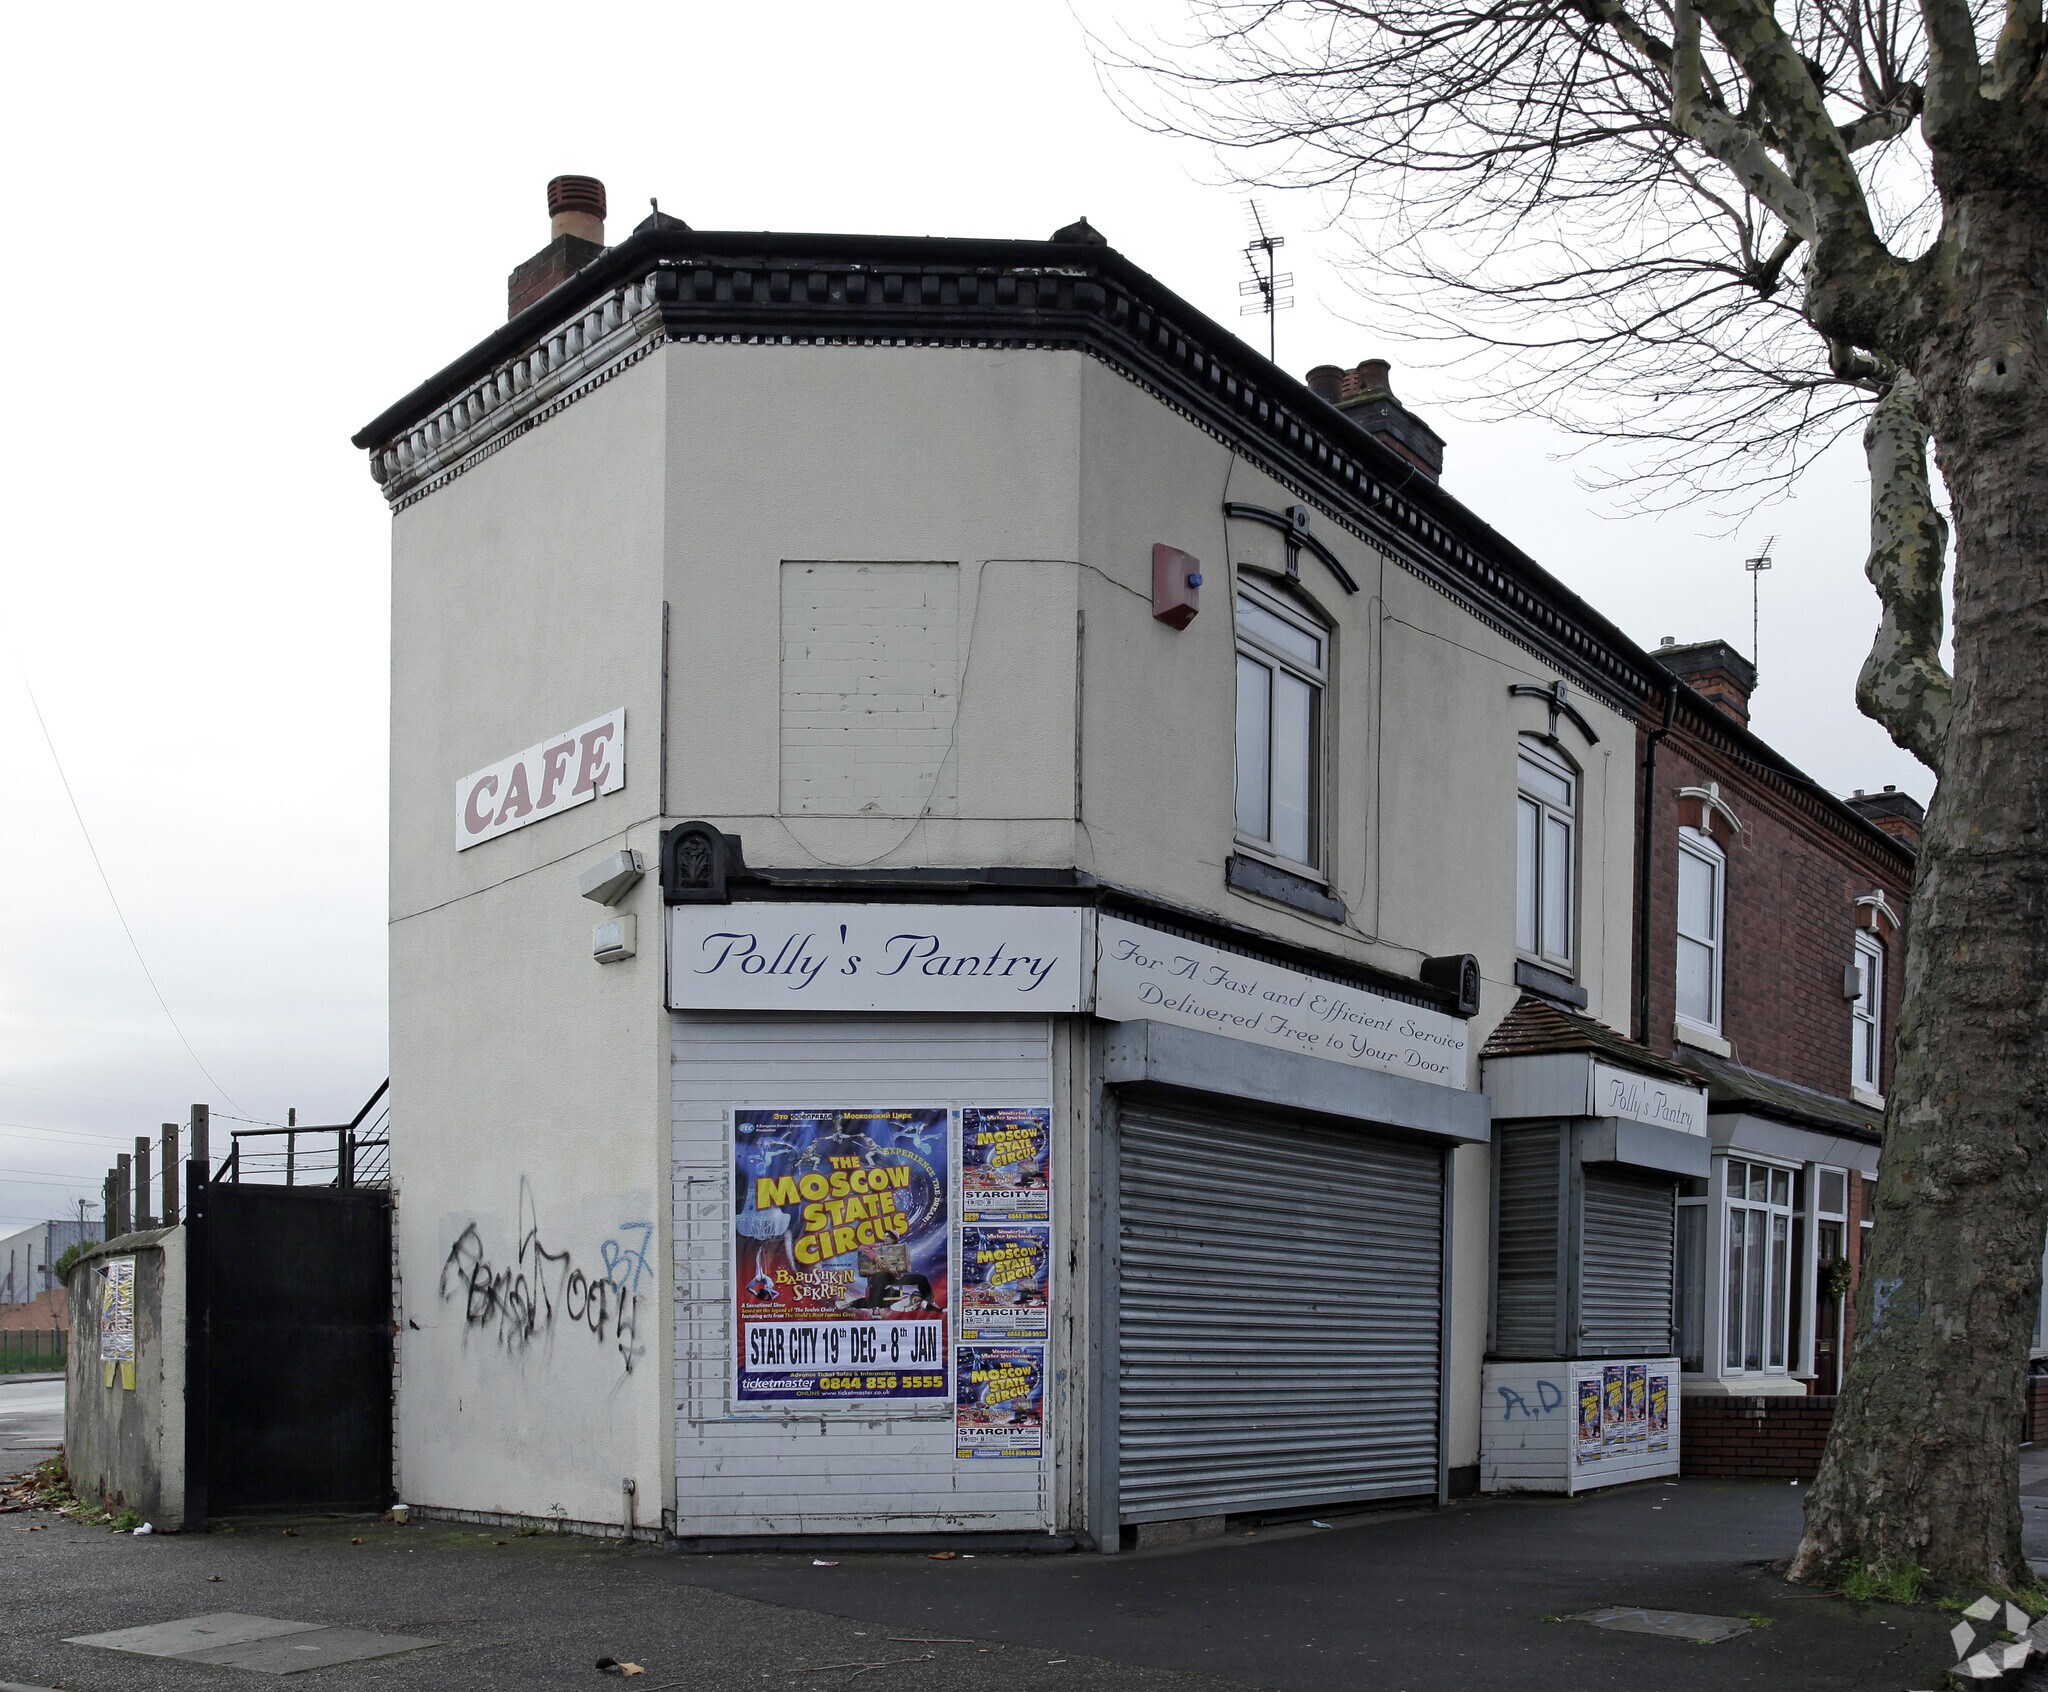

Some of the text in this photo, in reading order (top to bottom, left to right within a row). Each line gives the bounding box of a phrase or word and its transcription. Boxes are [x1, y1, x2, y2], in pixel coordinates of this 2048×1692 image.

[464, 721, 615, 835] CAFE
[693, 923, 1059, 992] Polly's Pantry
[1110, 939, 1465, 1052] For A Fast and Efficient Service
[1138, 981, 1451, 1075] Delivered Free to Your Door
[1608, 1079, 1694, 1134] Polly's Pantry
[976, 1128, 1038, 1146] MOSCOW
[995, 1138, 1032, 1155] STATE
[829, 1156, 861, 1170] THE
[883, 1147, 936, 1178] EXPERIENCE
[991, 1147, 1037, 1168] CIRCUS
[756, 1165, 911, 1210] MOSCOW
[802, 1191, 897, 1233] STATE
[794, 1211, 910, 1265] CIRCUS
[976, 1247, 1038, 1264] MOSCOW
[994, 1257, 1032, 1273] STATE
[991, 1265, 1036, 1286] CIRCUS
[751, 1327, 785, 1366] STAR
[789, 1327, 818, 1365] CITY
[823, 1327, 847, 1364] 19th
[850, 1326, 877, 1364] DEC
[891, 1326, 908, 1363] 8th
[911, 1325, 937, 1363] JAN
[742, 1375, 943, 1390] ticketmaster 0844 856 5555
[971, 1366, 1032, 1384] MOSCOW
[989, 1377, 1026, 1393] STATE
[985, 1384, 1031, 1405] CIRCUS
